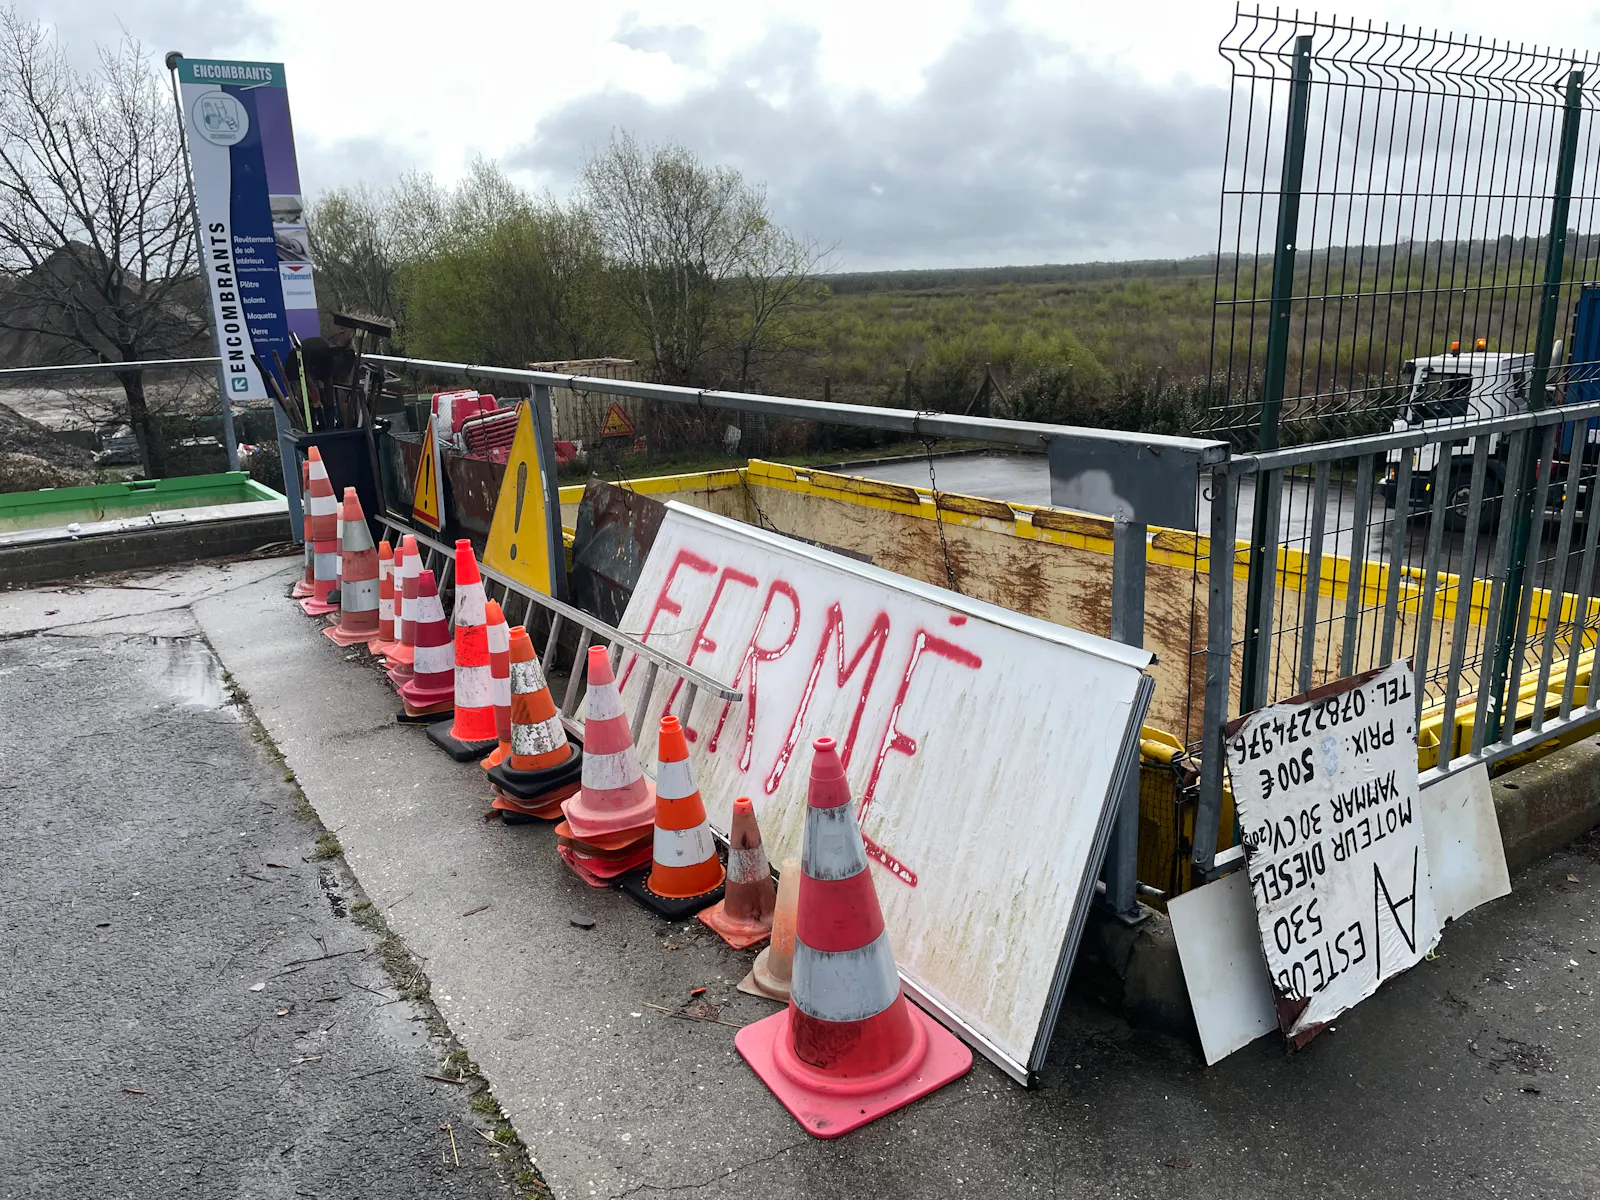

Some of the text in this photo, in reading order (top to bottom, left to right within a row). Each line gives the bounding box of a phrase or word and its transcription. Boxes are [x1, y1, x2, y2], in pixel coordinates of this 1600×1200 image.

[193, 64, 272, 80] ENCOMBRANTS
[233, 235, 274, 243] Revêtements
[209, 222, 246, 374] ENCOMBRANTS
[247, 312, 277, 320] Moquette
[1233, 674, 1411, 765] TEL: 0782274976
[1259, 769, 1275, 800] €
[1277, 747, 1314, 791] 500
[1252, 796, 1412, 904] MOTEUR DIESEL
[1273, 898, 1323, 954] 530
